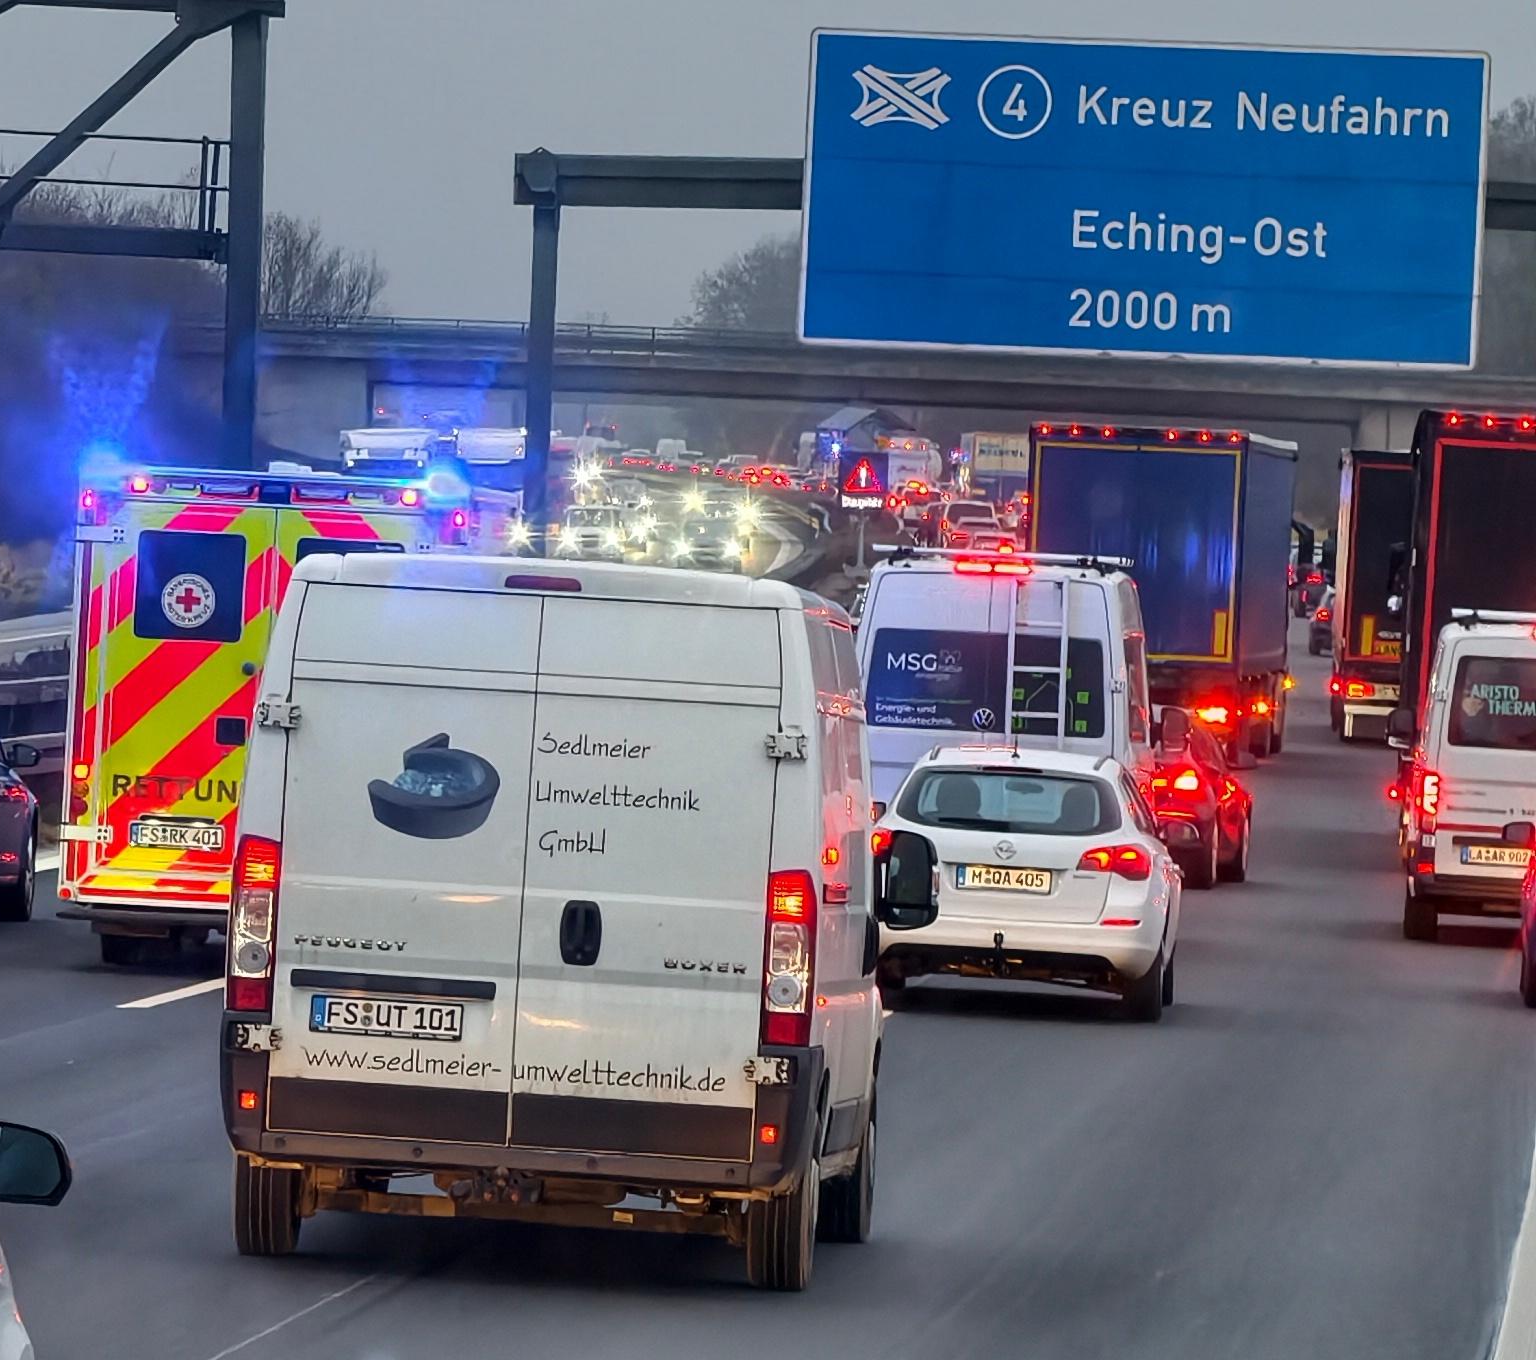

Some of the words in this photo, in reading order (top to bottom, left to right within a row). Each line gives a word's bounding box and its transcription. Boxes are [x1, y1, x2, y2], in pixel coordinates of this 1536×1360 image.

[1002, 83, 1028, 122] 4
[1077, 85, 1212, 129] Kreuz
[1237, 91, 1450, 139] Neufahrn
[1072, 210, 1327, 264] Eching-Ost
[1068, 288, 1178, 331] 2000
[1191, 301, 1232, 333] m
[887, 652, 937, 671] MSG
[1472, 684, 1519, 700] ARISTO
[537, 732, 651, 759] Sedlmeier
[112, 774, 238, 803] RETTUN
[536, 780, 700, 812] Umwelttechnik
[192, 830, 220, 845] 401
[539, 828, 606, 858] GmbH
[1015, 872, 1044, 888] 405
[294, 934, 408, 952] PEUGEOT
[664, 957, 747, 975] BOXER
[327, 1001, 359, 1025] FS
[376, 1005, 408, 1029] UT
[413, 1007, 458, 1032] 101
